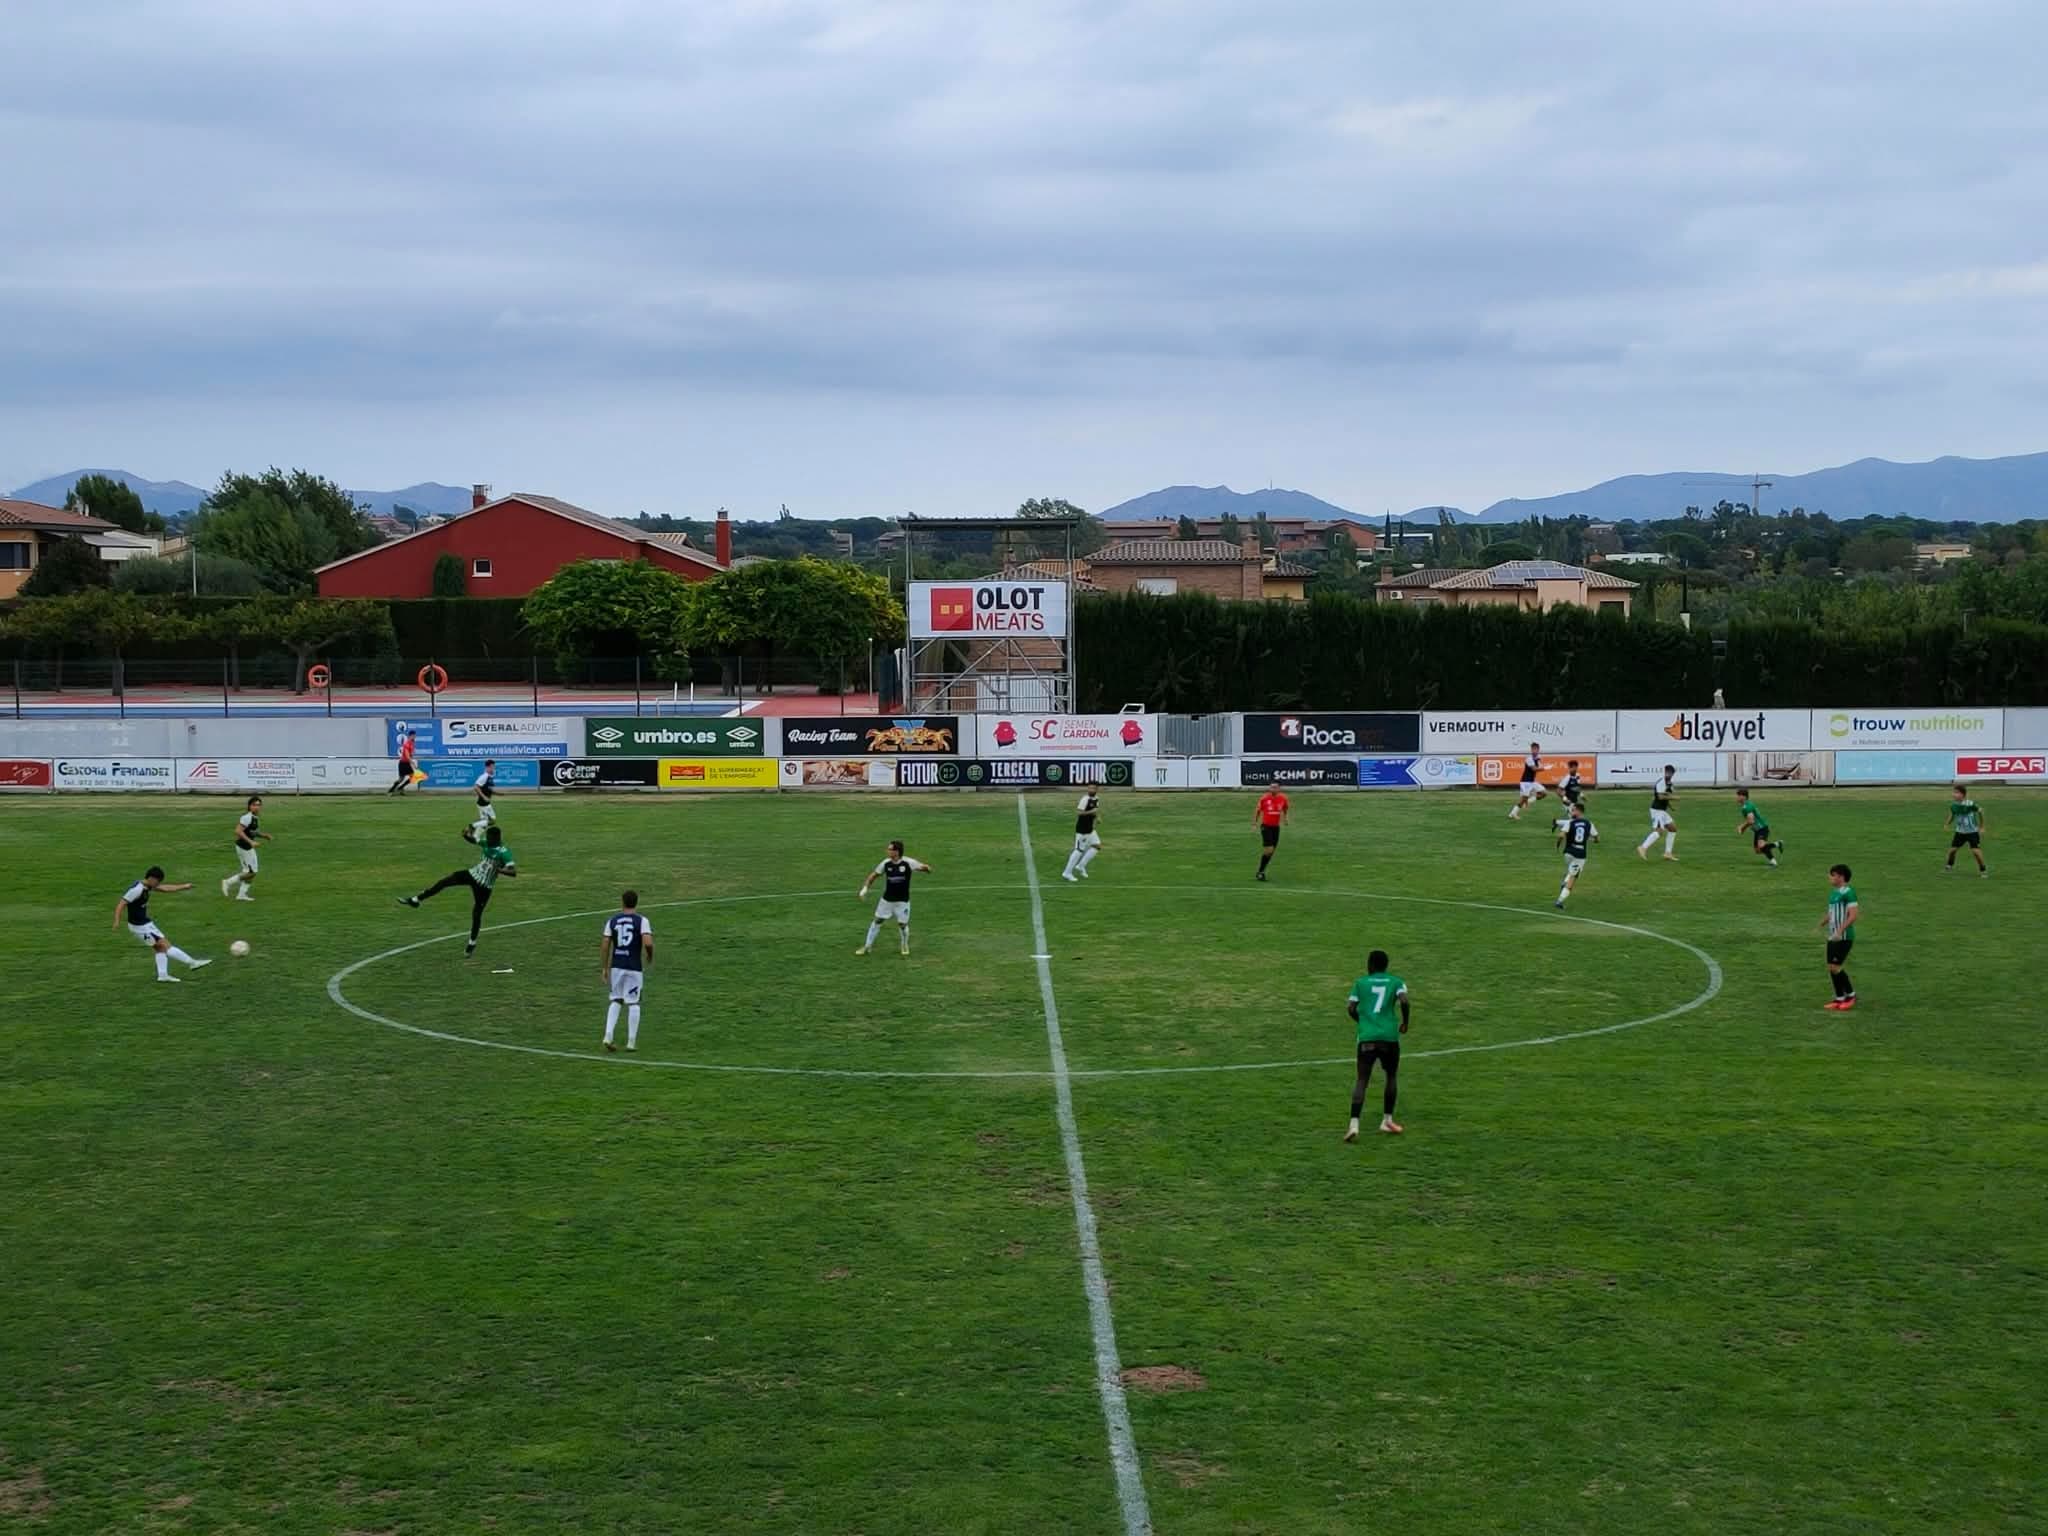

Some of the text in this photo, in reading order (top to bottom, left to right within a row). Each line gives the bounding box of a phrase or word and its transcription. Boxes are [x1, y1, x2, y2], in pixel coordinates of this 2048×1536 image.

[976, 587, 1045, 610] OLOT
[976, 612, 1044, 631] MEATS
[469, 722, 558, 732] SEVERAL ADVICE
[1028, 719, 1058, 740] SC
[1064, 720, 1097, 729] SEMEN
[1429, 721, 1505, 733] VERMOUTH
[1680, 712, 1765, 747] blayvet
[1853, 715, 1985, 731] trouw nutrition
[633, 729, 717, 744] umbro.es
[788, 729, 828, 745] Racing
[1062, 729, 1110, 738] CARDONA
[1302, 725, 1356, 745] Roca
[447, 745, 560, 756] www.severaladvice.com
[344, 766, 368, 775] CTC
[990, 762, 1039, 777] TERCERA
[1976, 759, 2045, 772] SPAR
[1575, 826, 1585, 843] 8
[614, 923, 634, 947] 15
[1371, 986, 1386, 1013] 7
